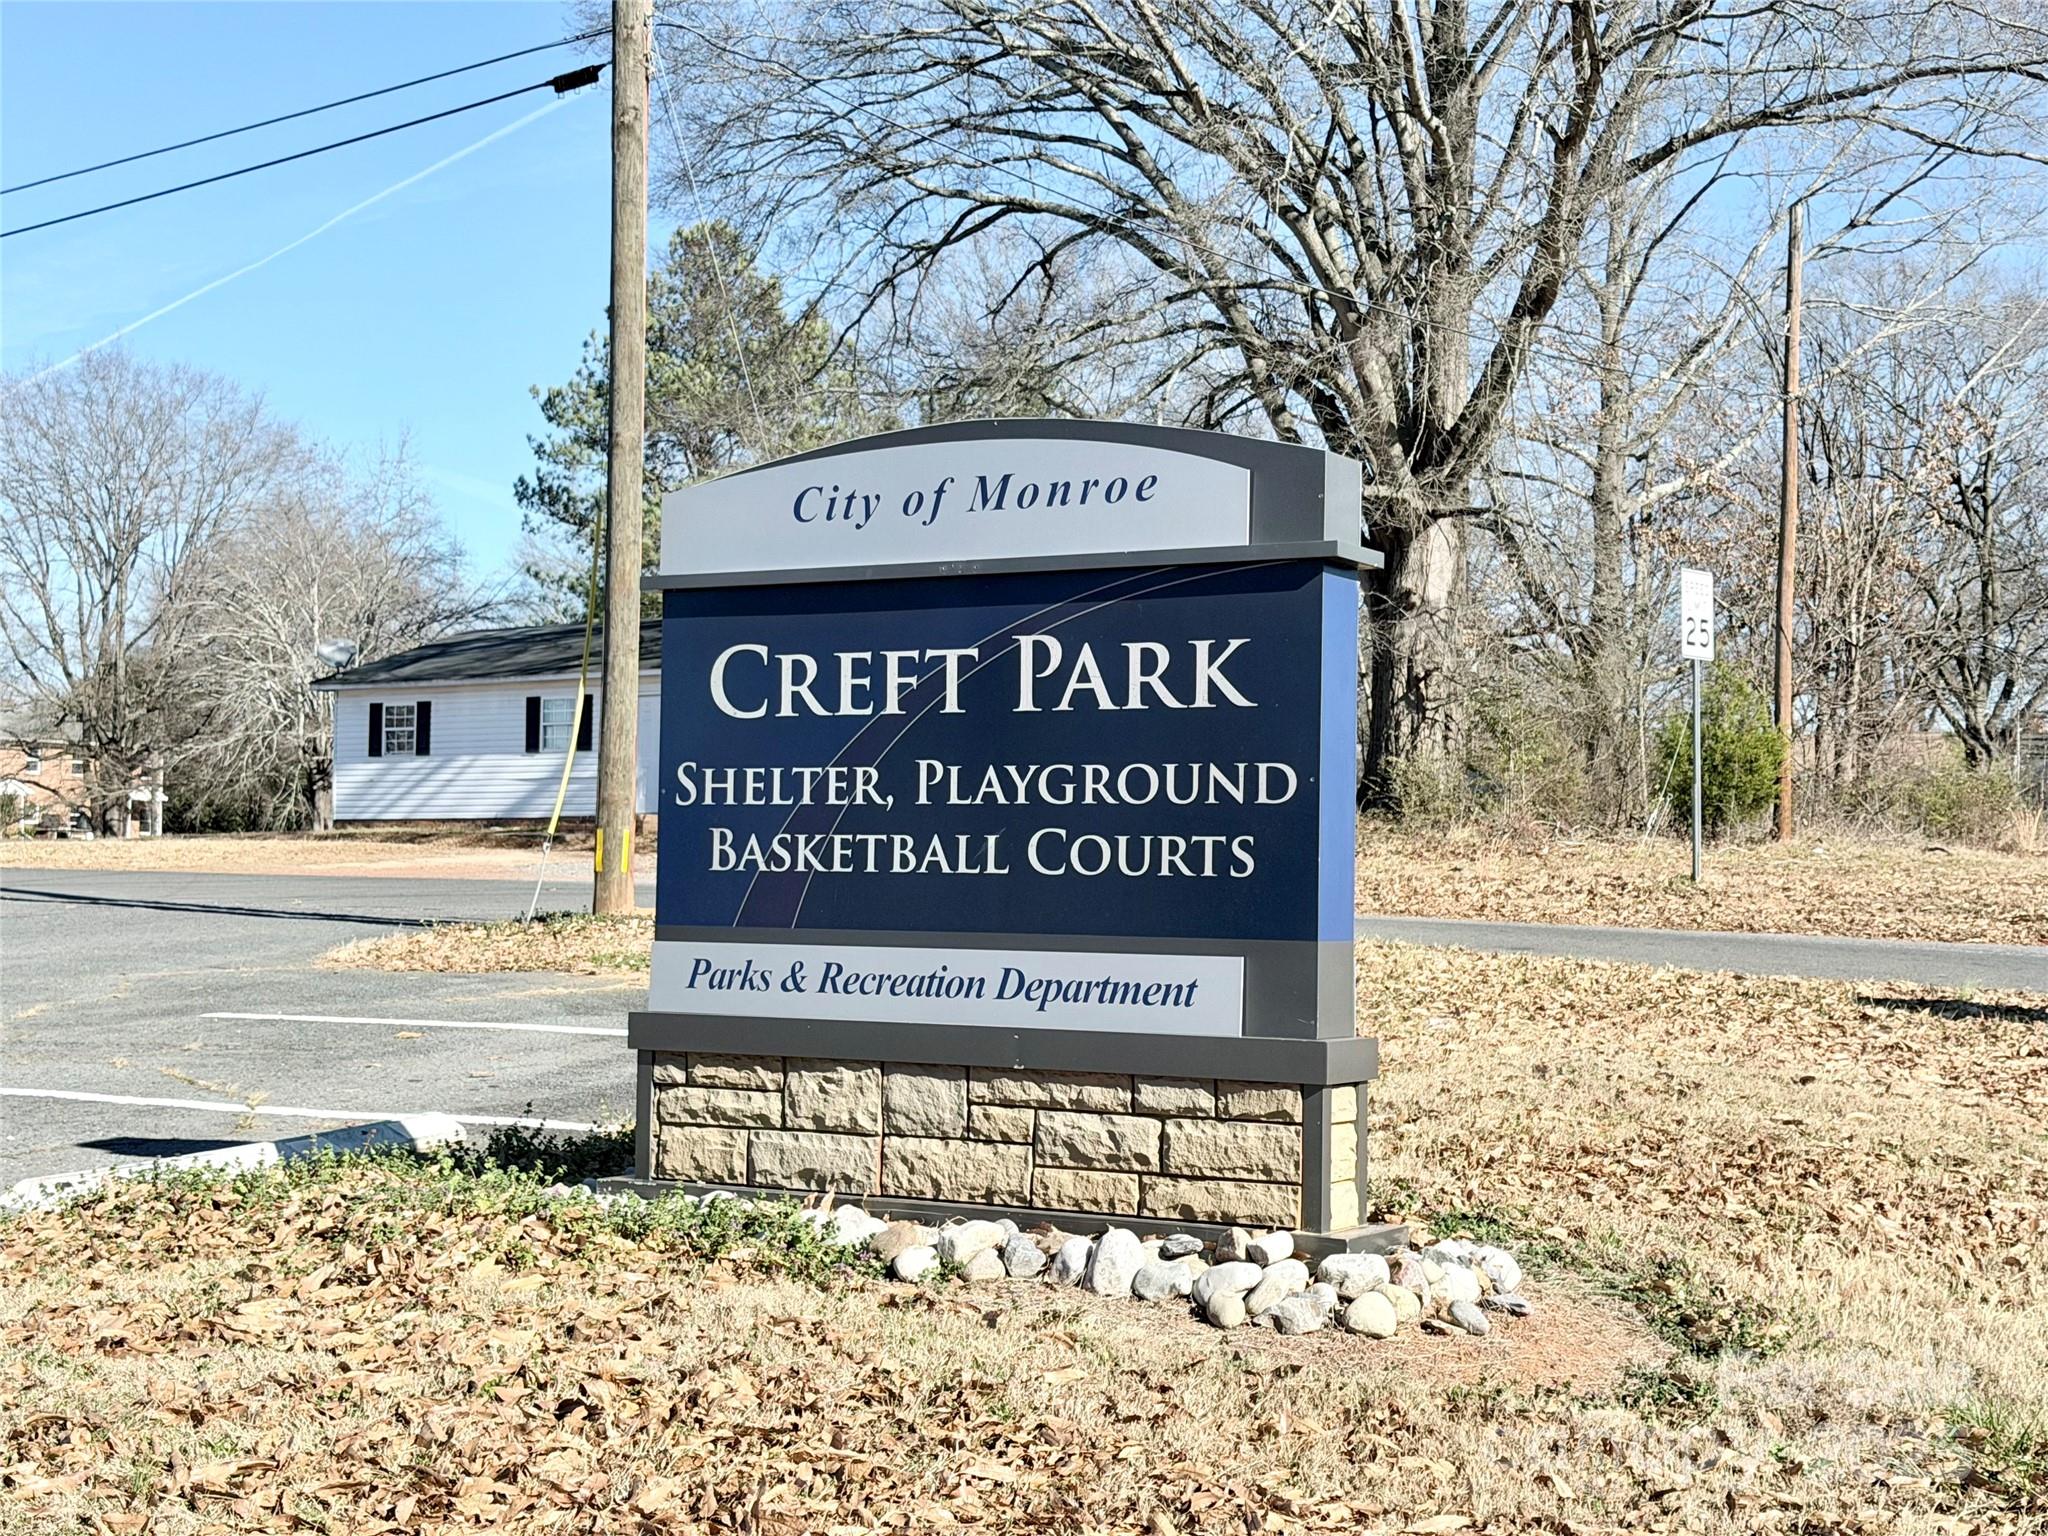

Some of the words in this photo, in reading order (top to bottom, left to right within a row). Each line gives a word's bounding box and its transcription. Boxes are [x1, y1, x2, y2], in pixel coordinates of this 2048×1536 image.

[794, 485, 880, 529] City
[903, 477, 954, 526] of
[967, 471, 1159, 513] Monroe
[1686, 617, 1709, 647] 25
[710, 643, 979, 720] CREFT
[1012, 635, 1258, 712] PARK
[676, 761, 894, 810] SHELTER,
[915, 759, 1298, 805] PLAYGROUND
[709, 828, 1009, 874] BASKETBALL
[1027, 827, 1255, 878] COURTS
[686, 958, 770, 992] Parks
[781, 961, 808, 994] &
[816, 962, 986, 1000] Recreation
[994, 967, 1199, 1012] Department
